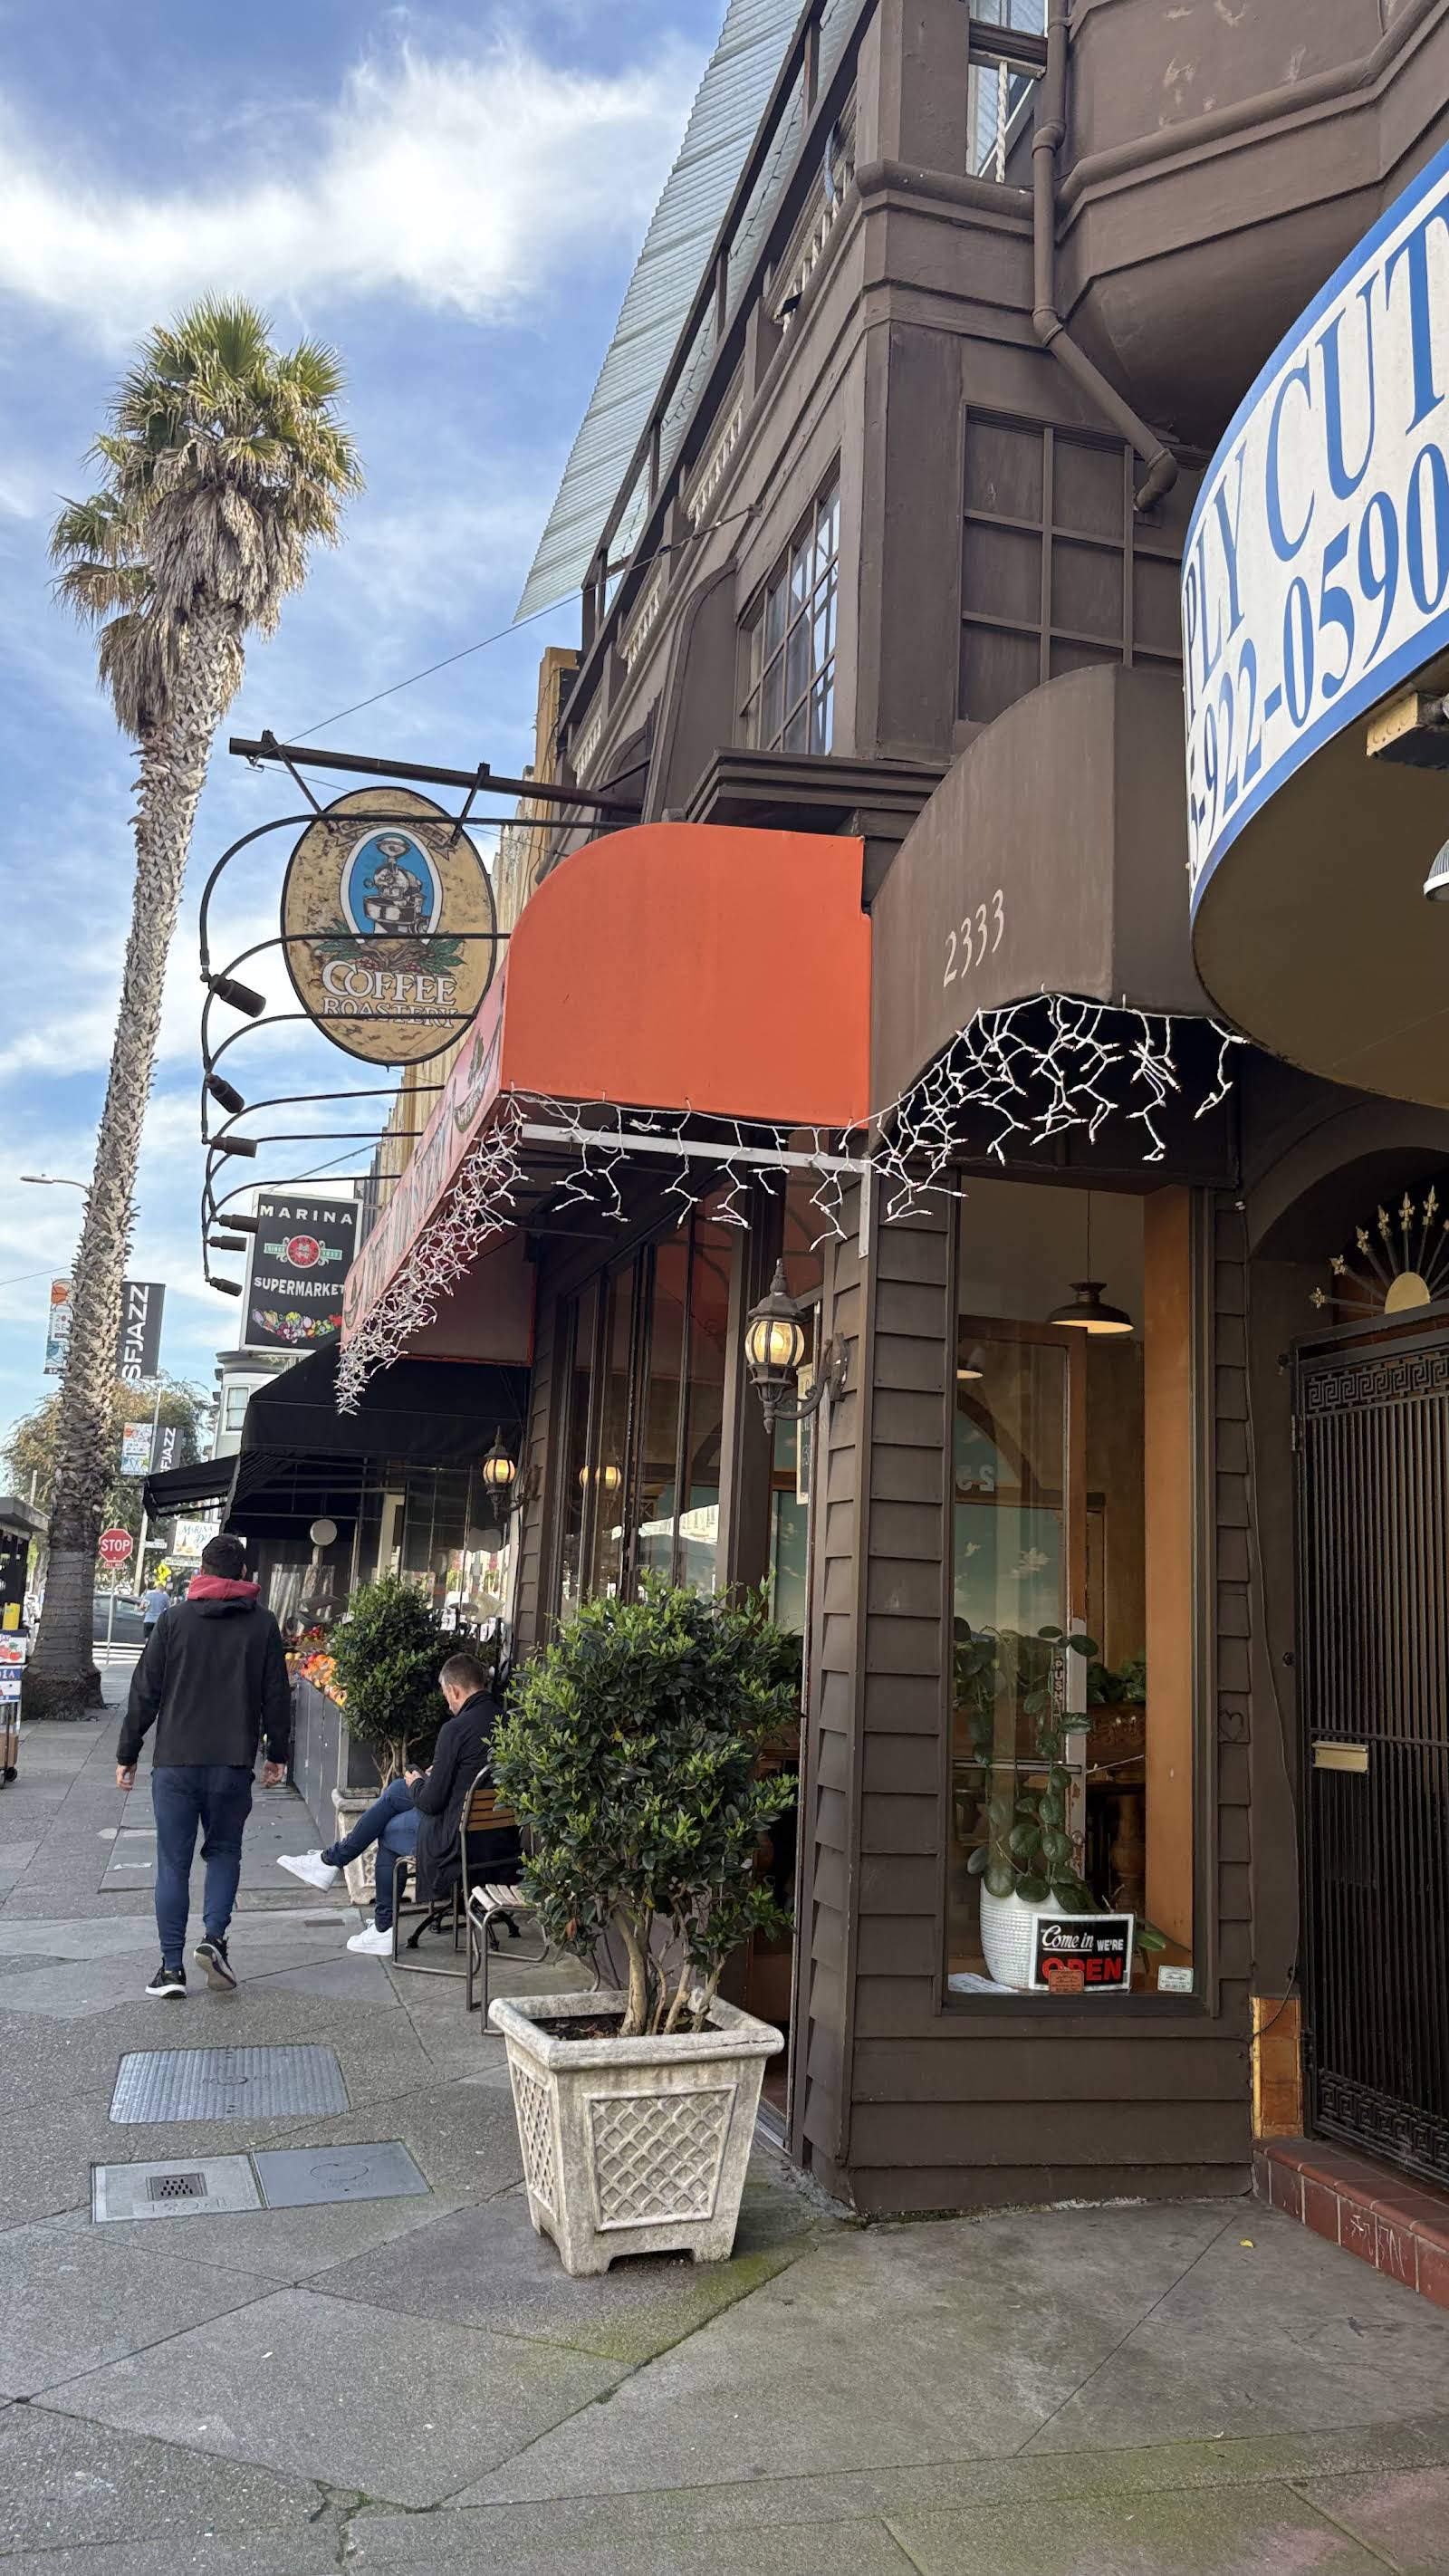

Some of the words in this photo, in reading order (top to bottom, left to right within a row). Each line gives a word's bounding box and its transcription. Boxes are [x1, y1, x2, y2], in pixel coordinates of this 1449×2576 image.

[1181, 438, 1247, 746] PLY
[1265, 192, 1449, 563] CUT
[1187, 443, 1449, 885] 5-922-0590
[943, 889, 1004, 987] 2333
[321, 960, 457, 1006] COFFEE
[322, 996, 458, 1029] ROASTERY
[259, 1205, 353, 1225] MARINA
[254, 1276, 345, 1297] SUPERMARKET
[121, 1284, 149, 1379] SFJAZZ
[101, 1539, 130, 1552] STOP
[1054, 1659, 1063, 1700] PUSH
[1042, 1925, 1080, 1948] Come
[1080, 1932, 1094, 1948] in
[1097, 1938, 1124, 1952] WE'RE
